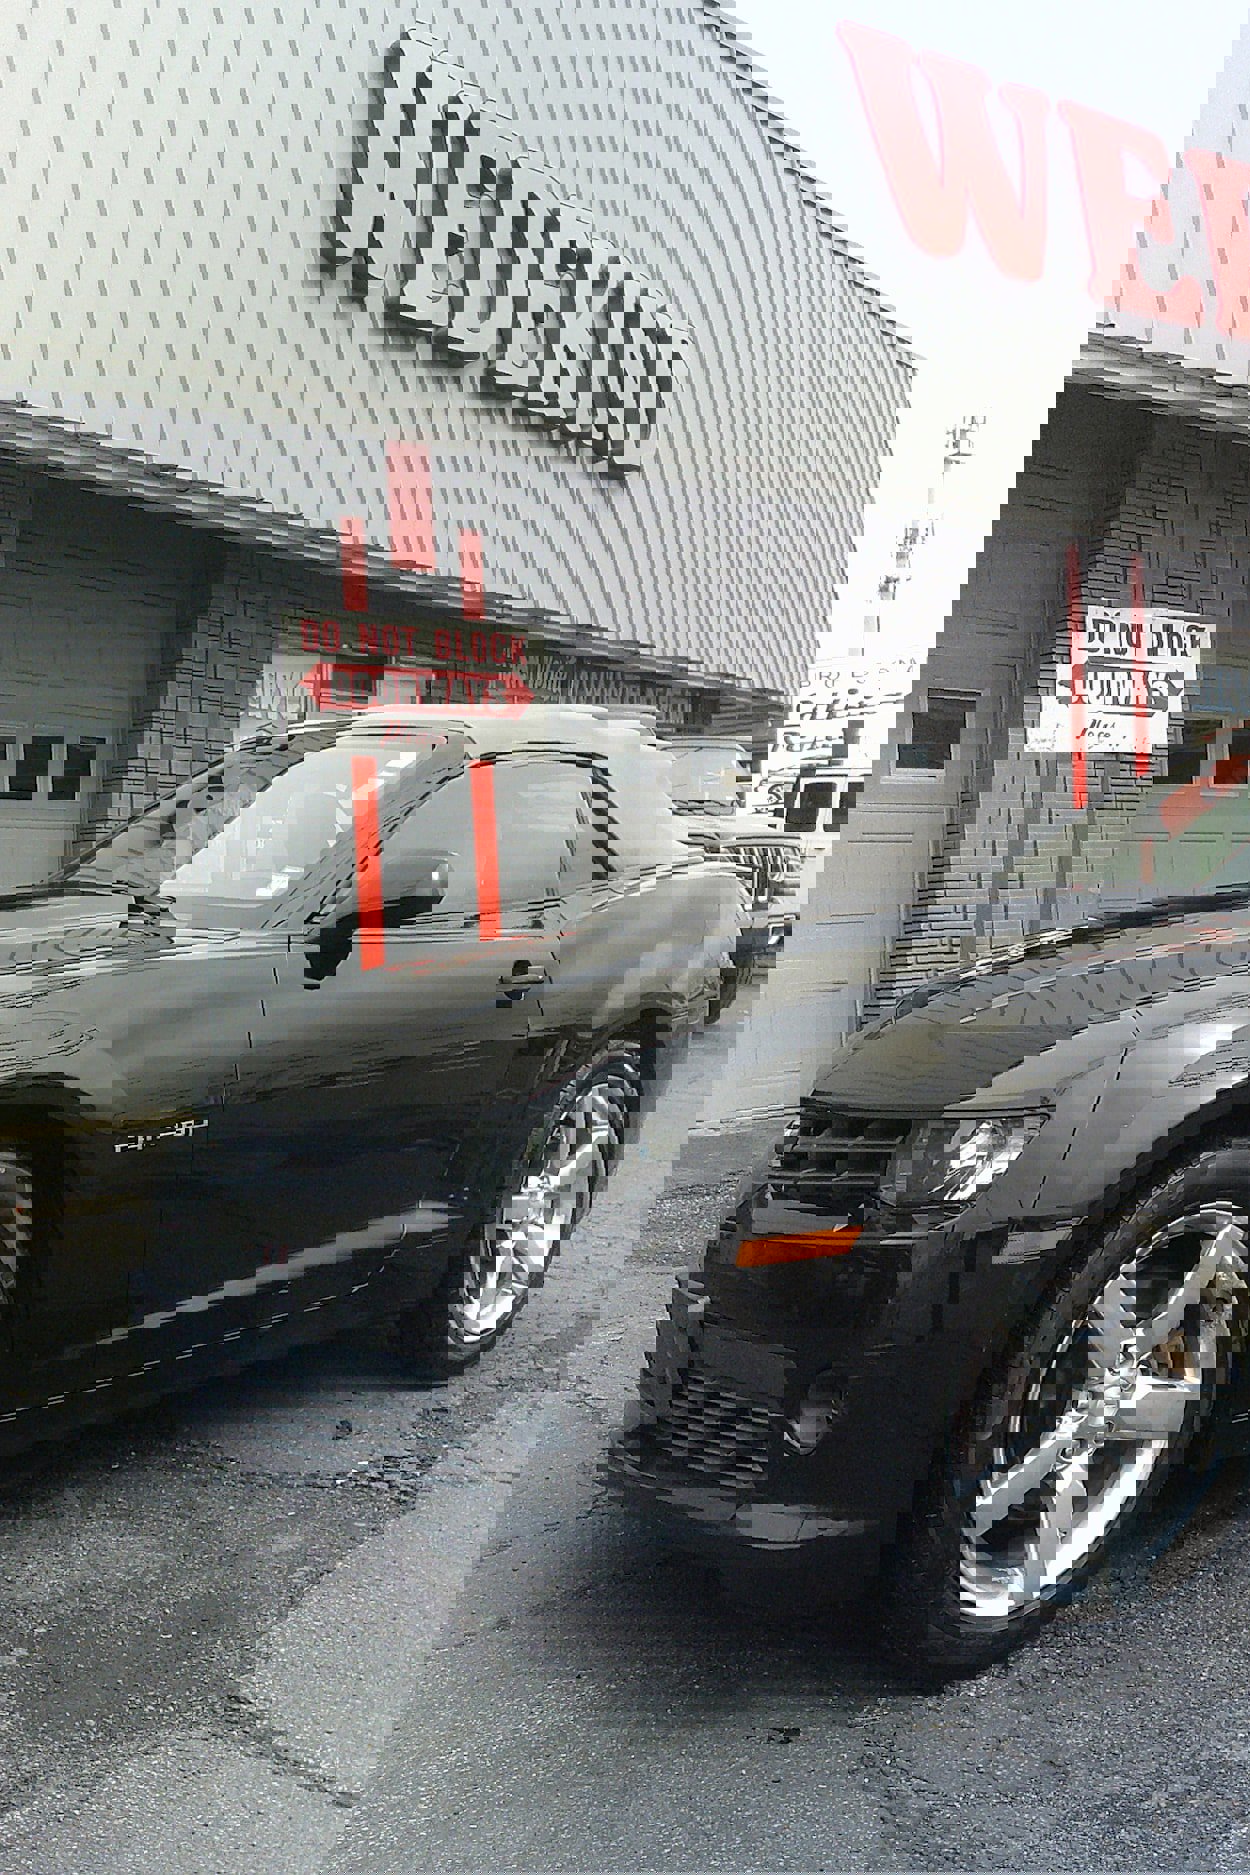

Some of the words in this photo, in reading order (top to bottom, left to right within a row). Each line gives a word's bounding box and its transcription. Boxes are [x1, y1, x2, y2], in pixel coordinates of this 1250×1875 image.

[299, 618, 341, 652] DO
[358, 622, 418, 657] NOT
[434, 628, 528, 666] BLOCK
